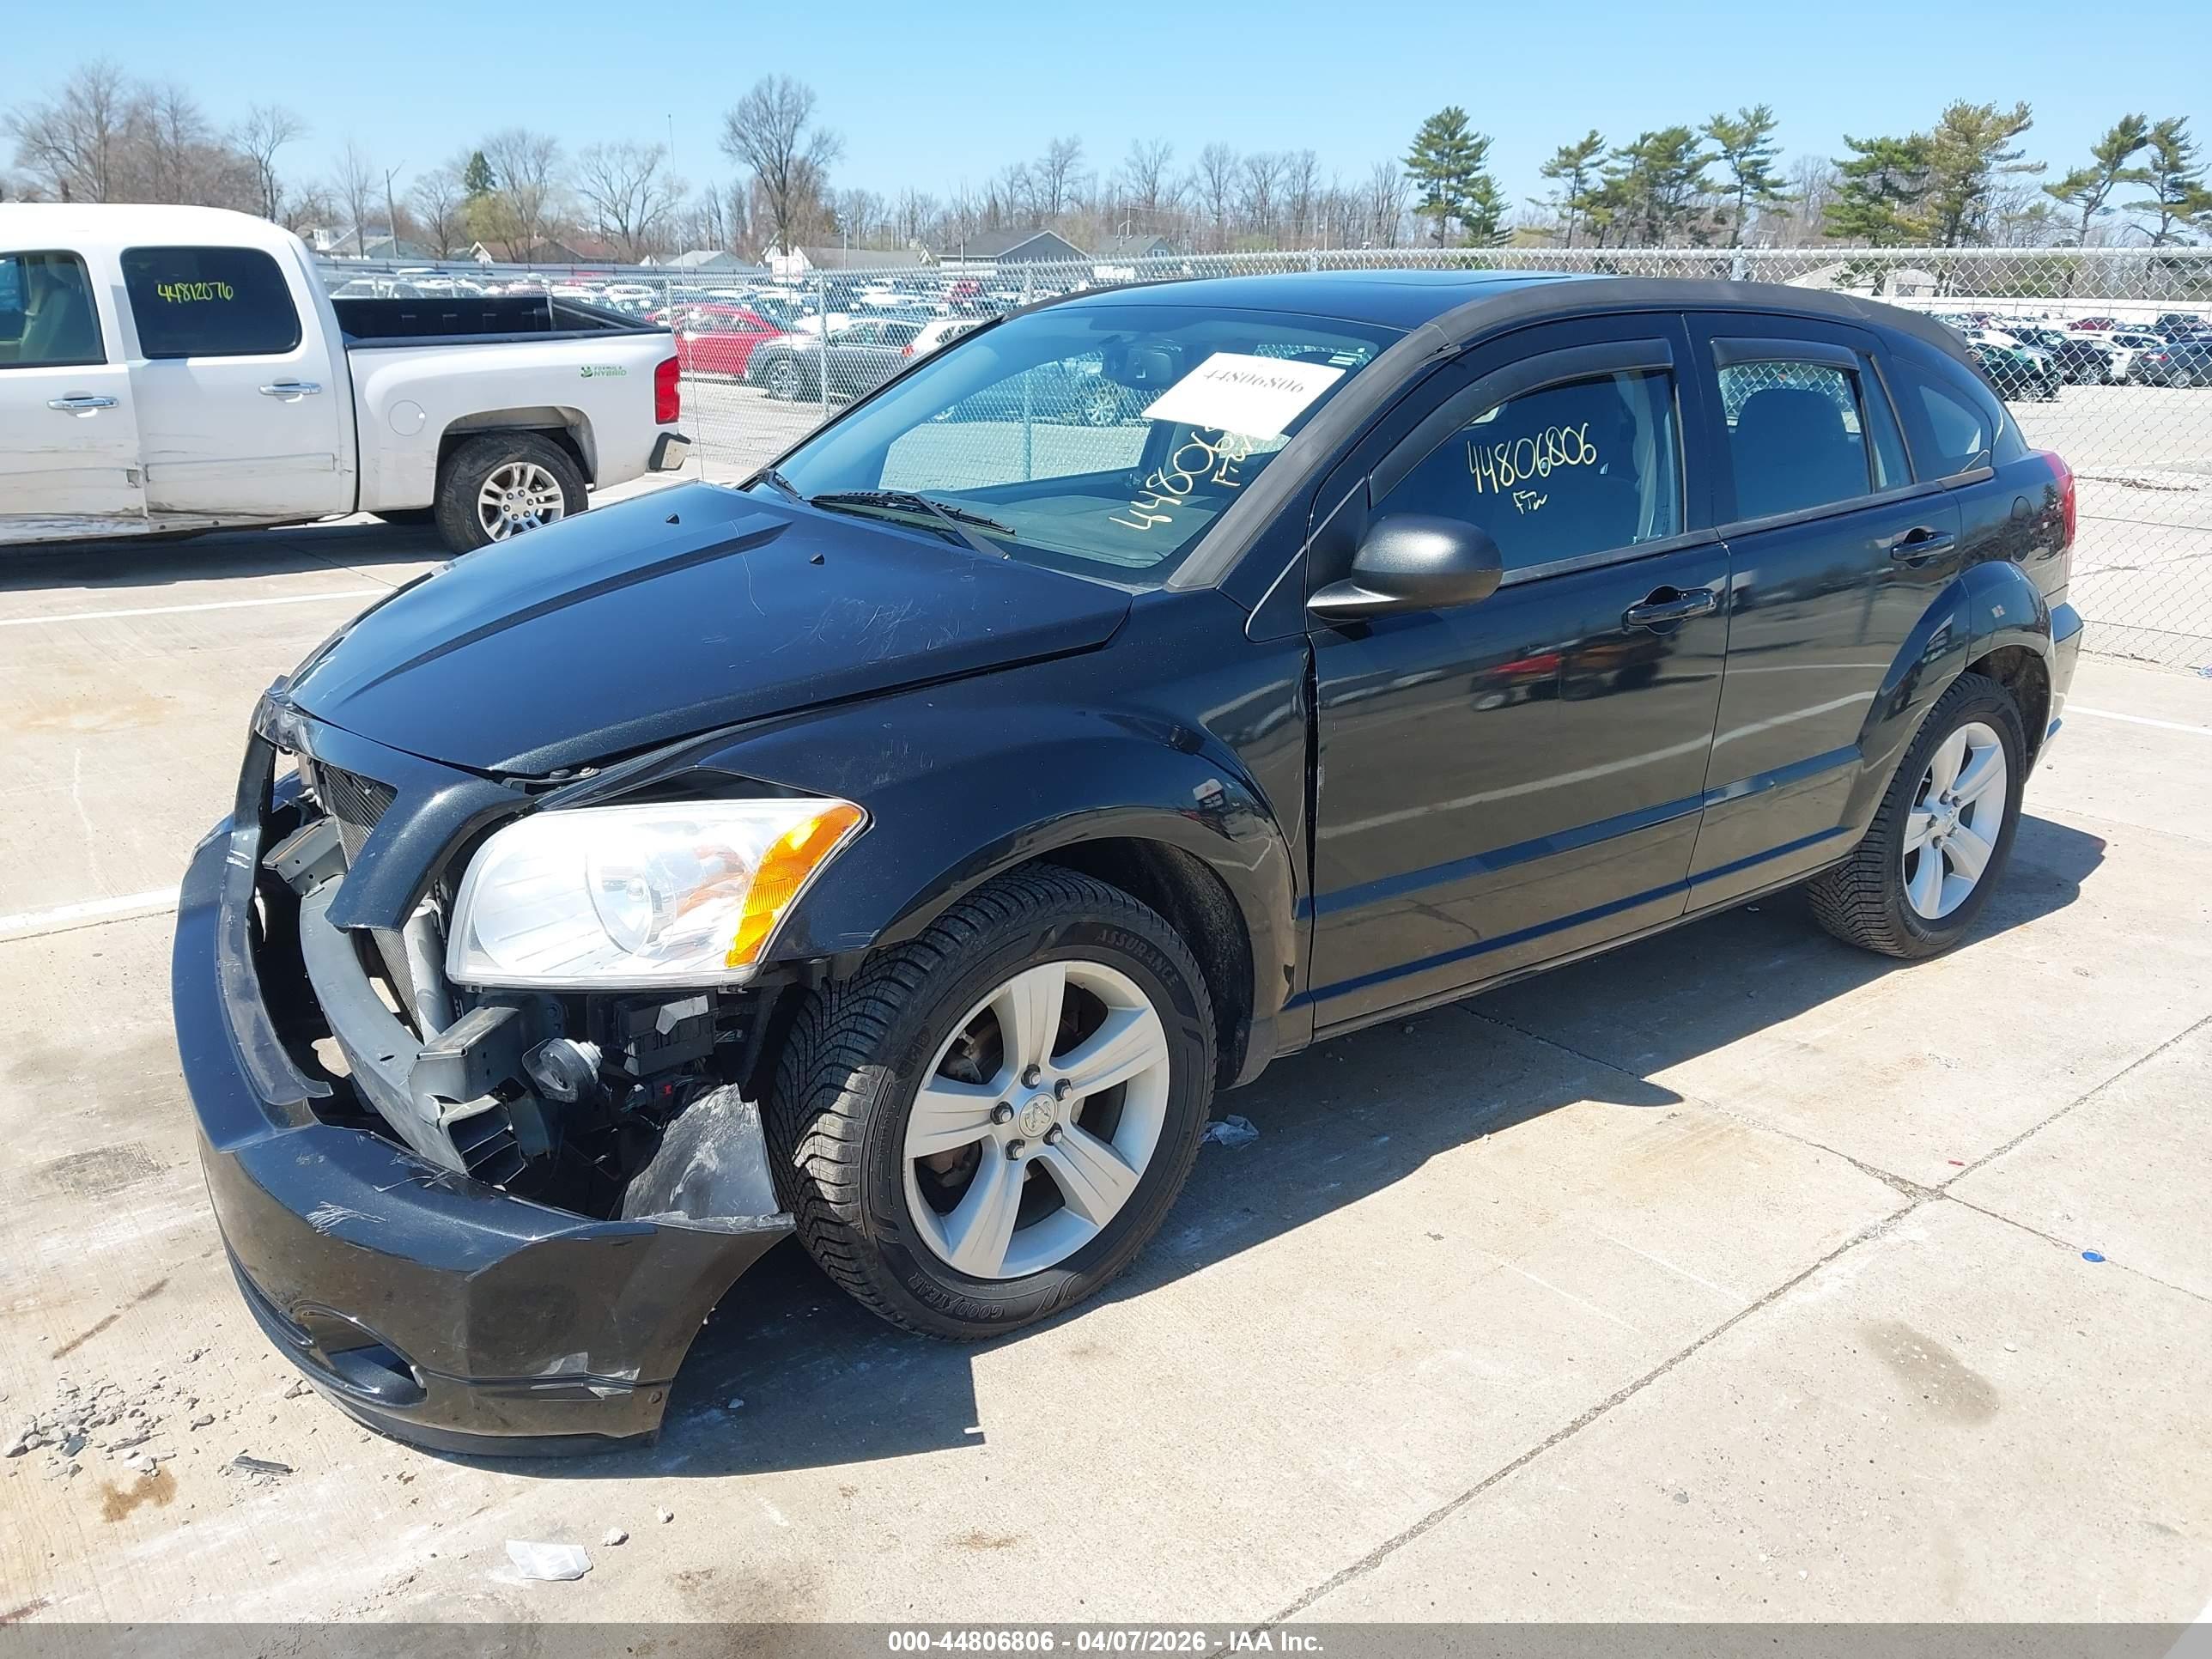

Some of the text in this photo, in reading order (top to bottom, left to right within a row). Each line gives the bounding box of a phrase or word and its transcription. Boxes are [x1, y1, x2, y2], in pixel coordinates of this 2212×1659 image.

[157, 281, 234, 304] 44812076
[1203, 368, 1305, 394] 44806806
[1467, 422, 1598, 495] 44806806
